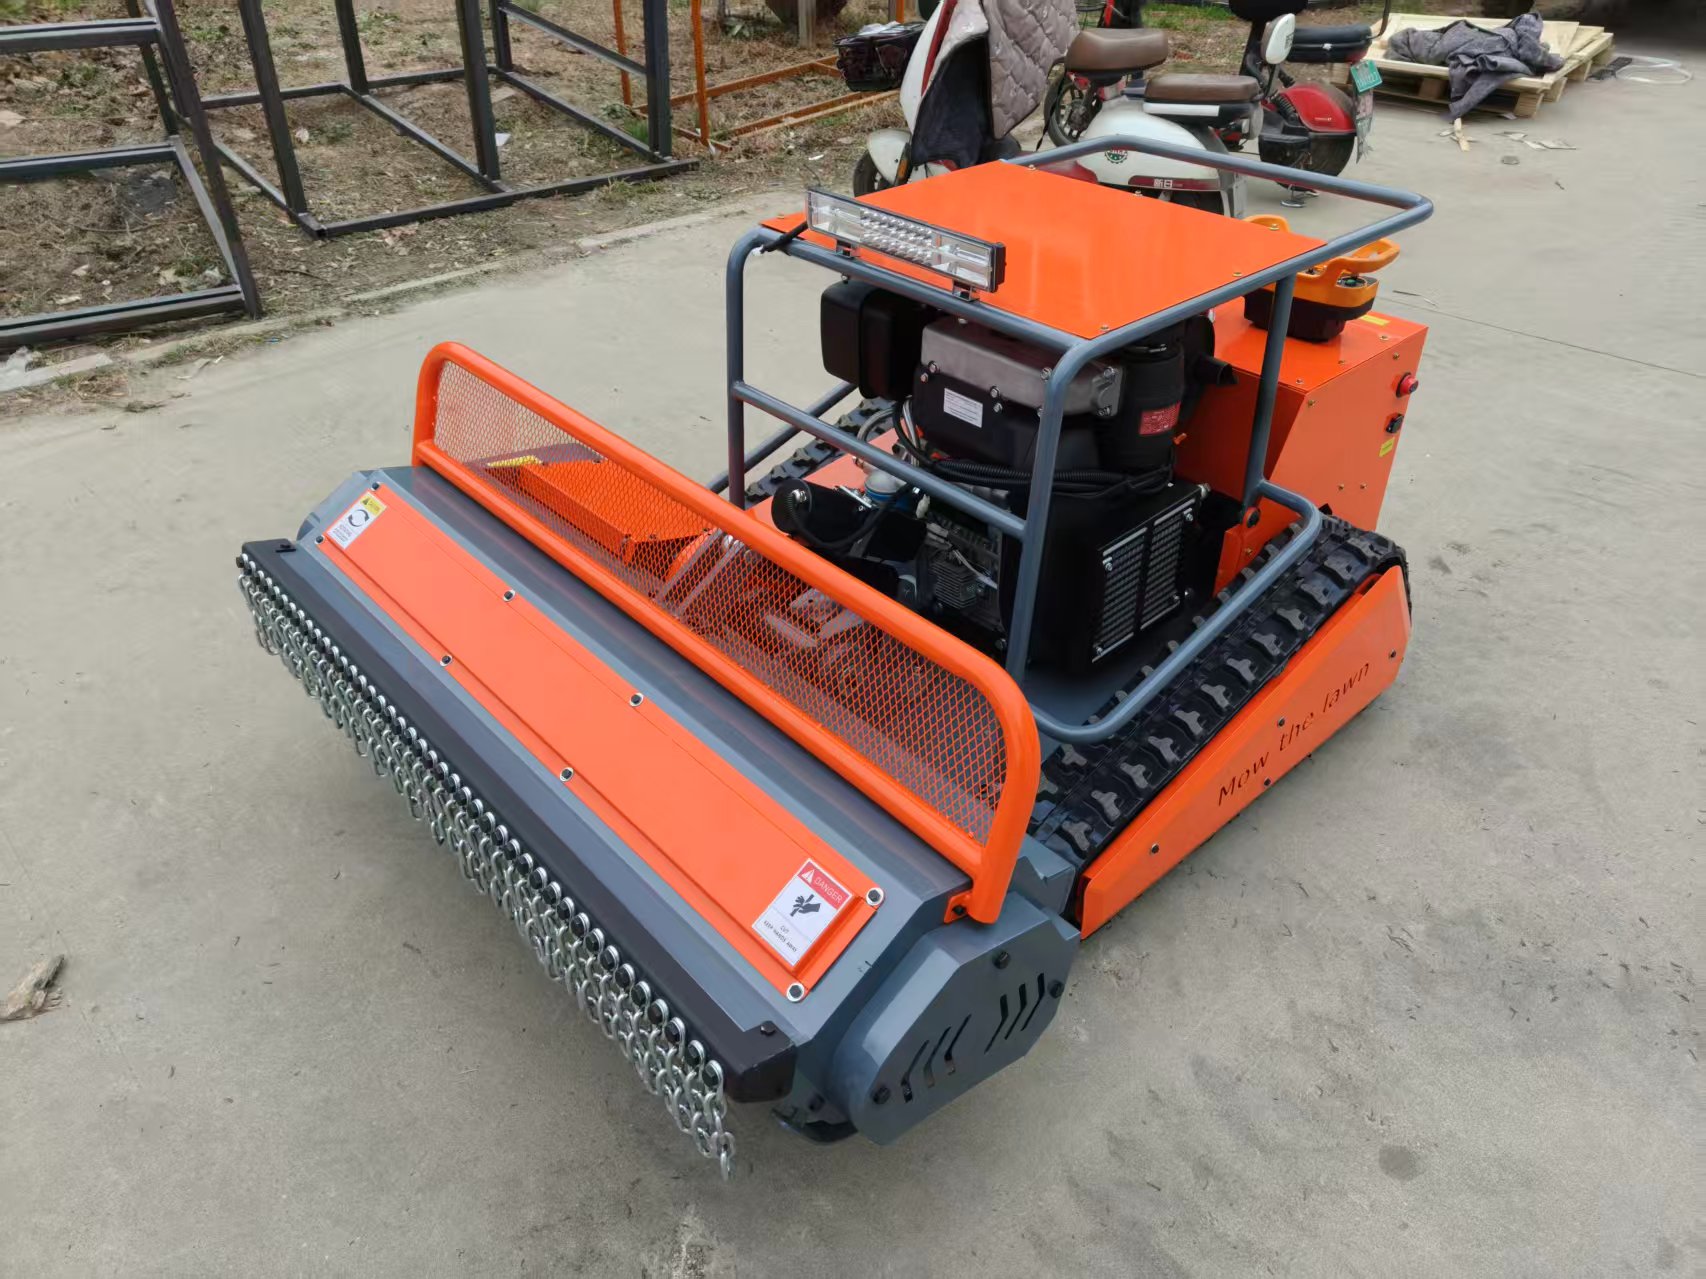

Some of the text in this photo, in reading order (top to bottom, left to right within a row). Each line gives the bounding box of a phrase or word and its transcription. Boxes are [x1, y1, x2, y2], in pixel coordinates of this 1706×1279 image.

[1218, 663, 1369, 806] Mow the lawn
[814, 876, 843, 904] DANGER
